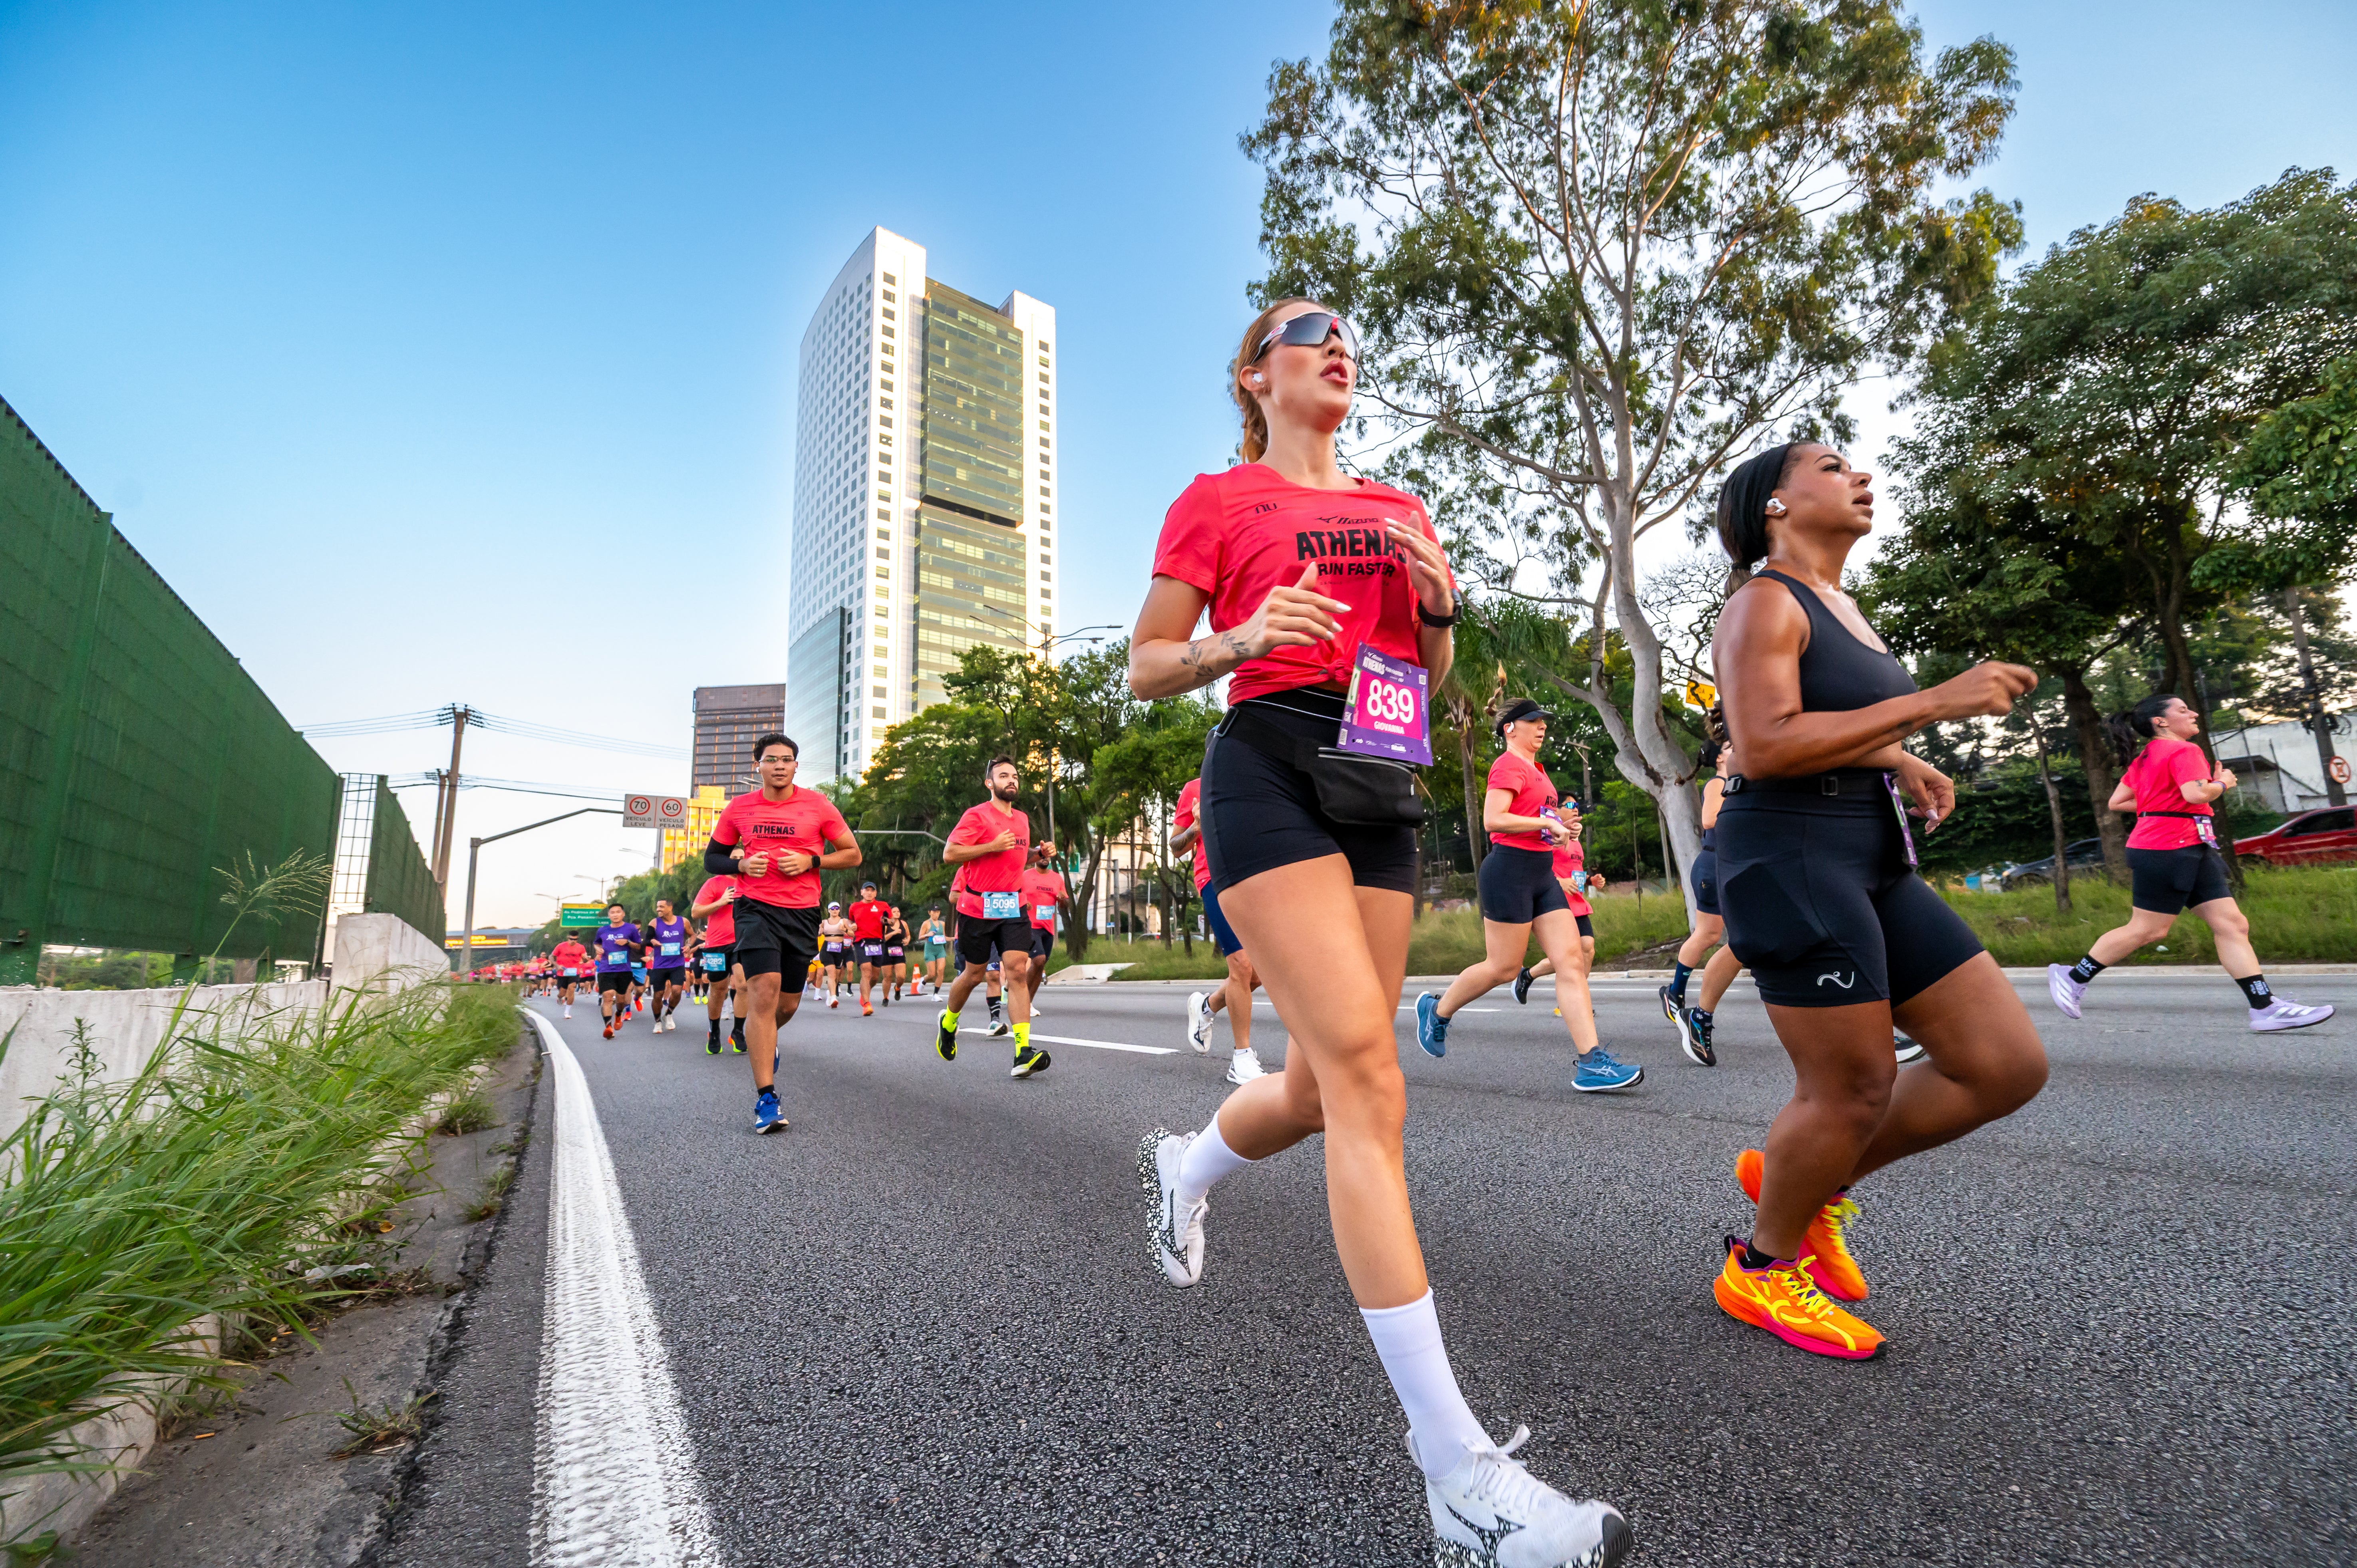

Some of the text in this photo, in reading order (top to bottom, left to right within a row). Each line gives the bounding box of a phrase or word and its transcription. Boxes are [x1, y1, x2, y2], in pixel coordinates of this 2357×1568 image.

[1347, 562, 1396, 578] FASTER
[1367, 679, 1415, 724] 839
[634, 801, 647, 810] 70
[666, 803, 679, 811] 60
[752, 825, 795, 835] ATHENAS
[992, 899, 1016, 909] 5095
